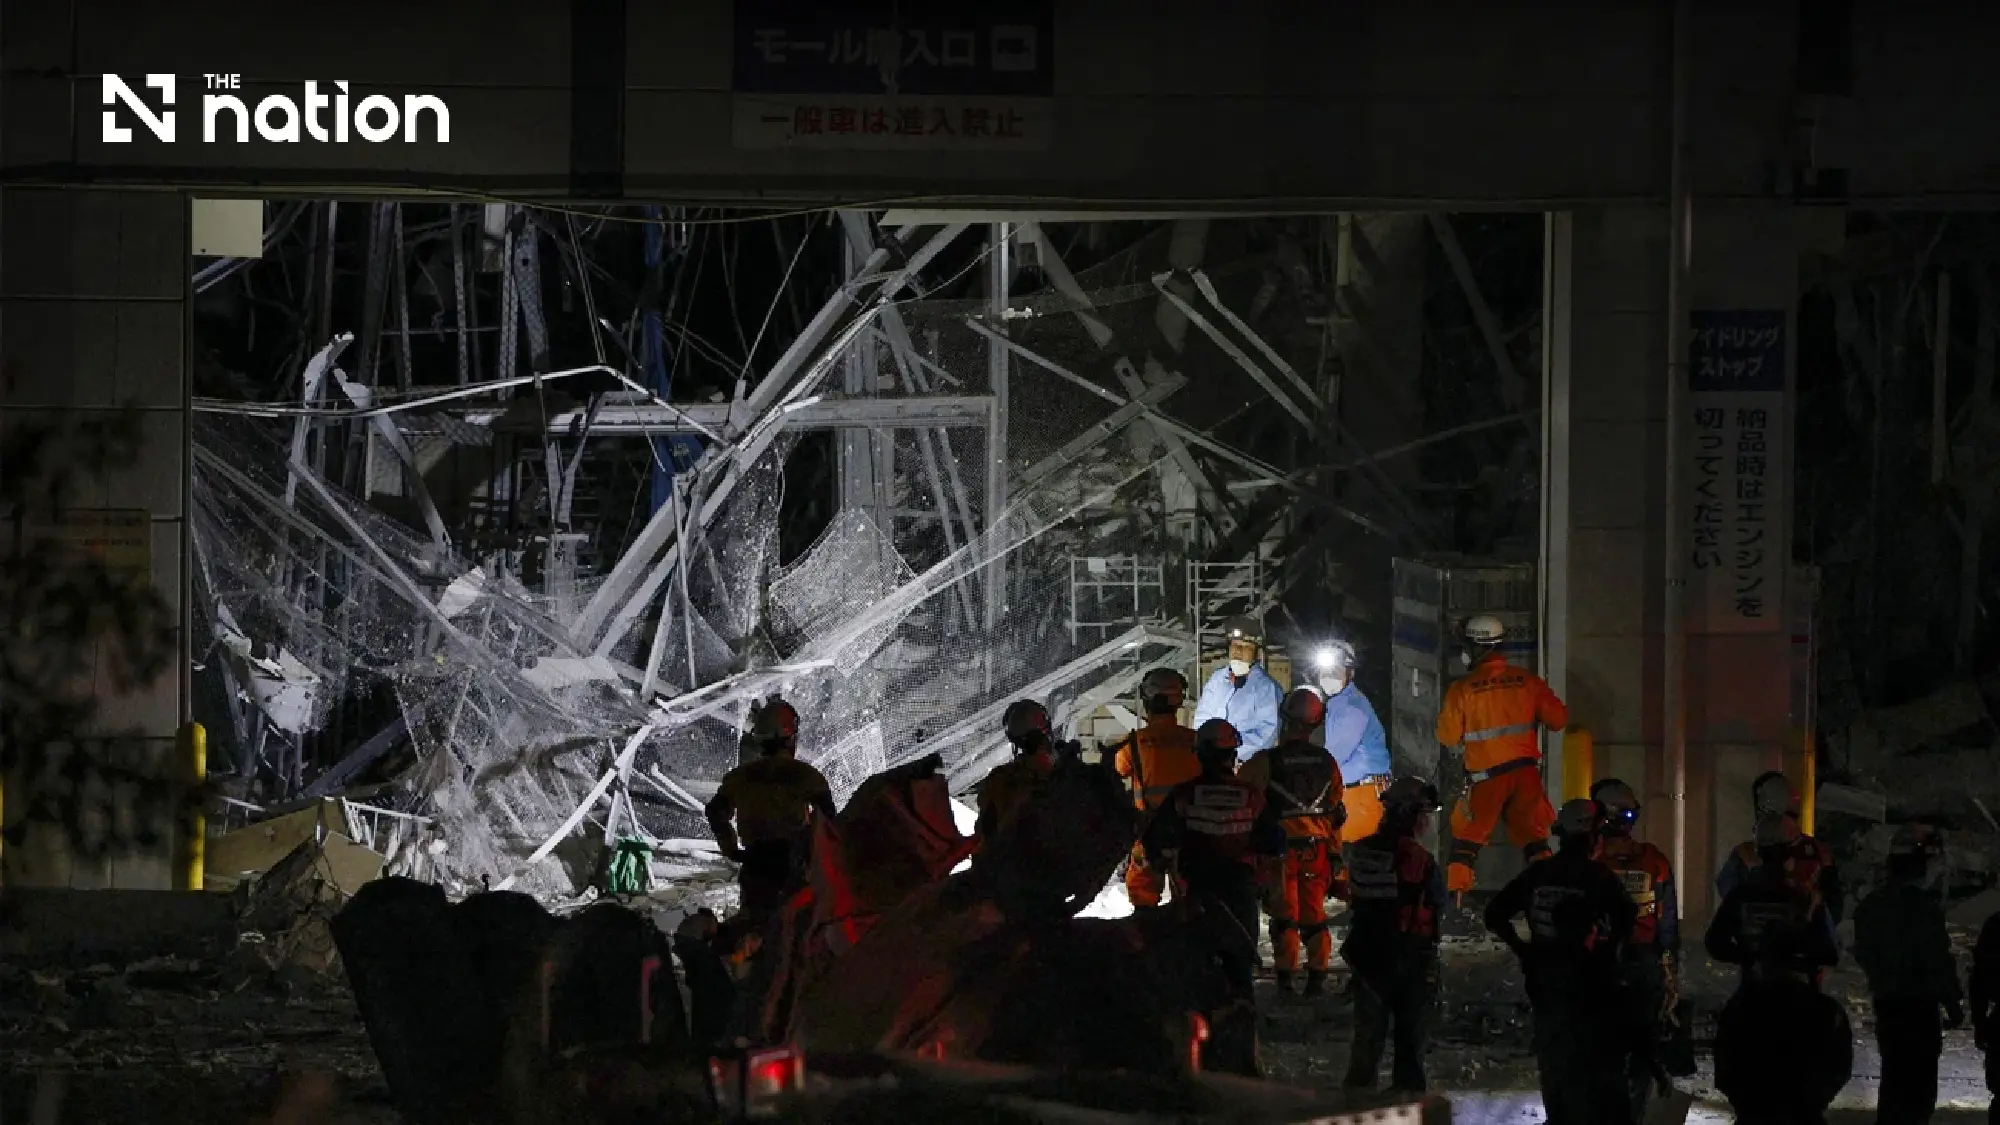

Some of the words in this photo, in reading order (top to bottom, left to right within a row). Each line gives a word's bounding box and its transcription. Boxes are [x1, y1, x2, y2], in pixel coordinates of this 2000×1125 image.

[761, 105, 1024, 138] 一般車は進入禁止
[1698, 355, 1764, 378] ストップ
[1692, 407, 1725, 570] 切ってください
[1735, 407, 1767, 618] 納品時はエンジンを
